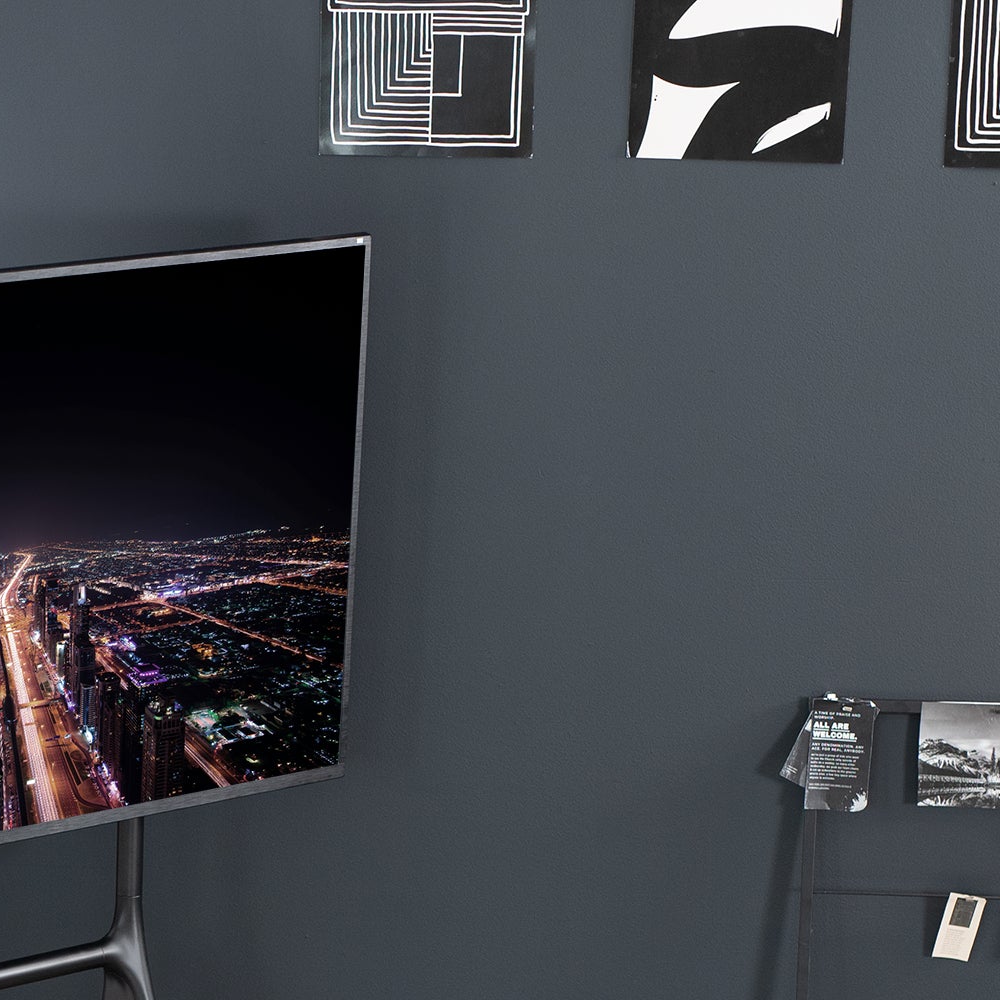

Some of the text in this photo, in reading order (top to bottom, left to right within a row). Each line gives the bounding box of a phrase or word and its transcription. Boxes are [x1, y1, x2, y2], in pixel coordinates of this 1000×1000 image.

[813, 721, 850, 730] ALL ARE
[812, 730, 858, 740] WELCOME.
